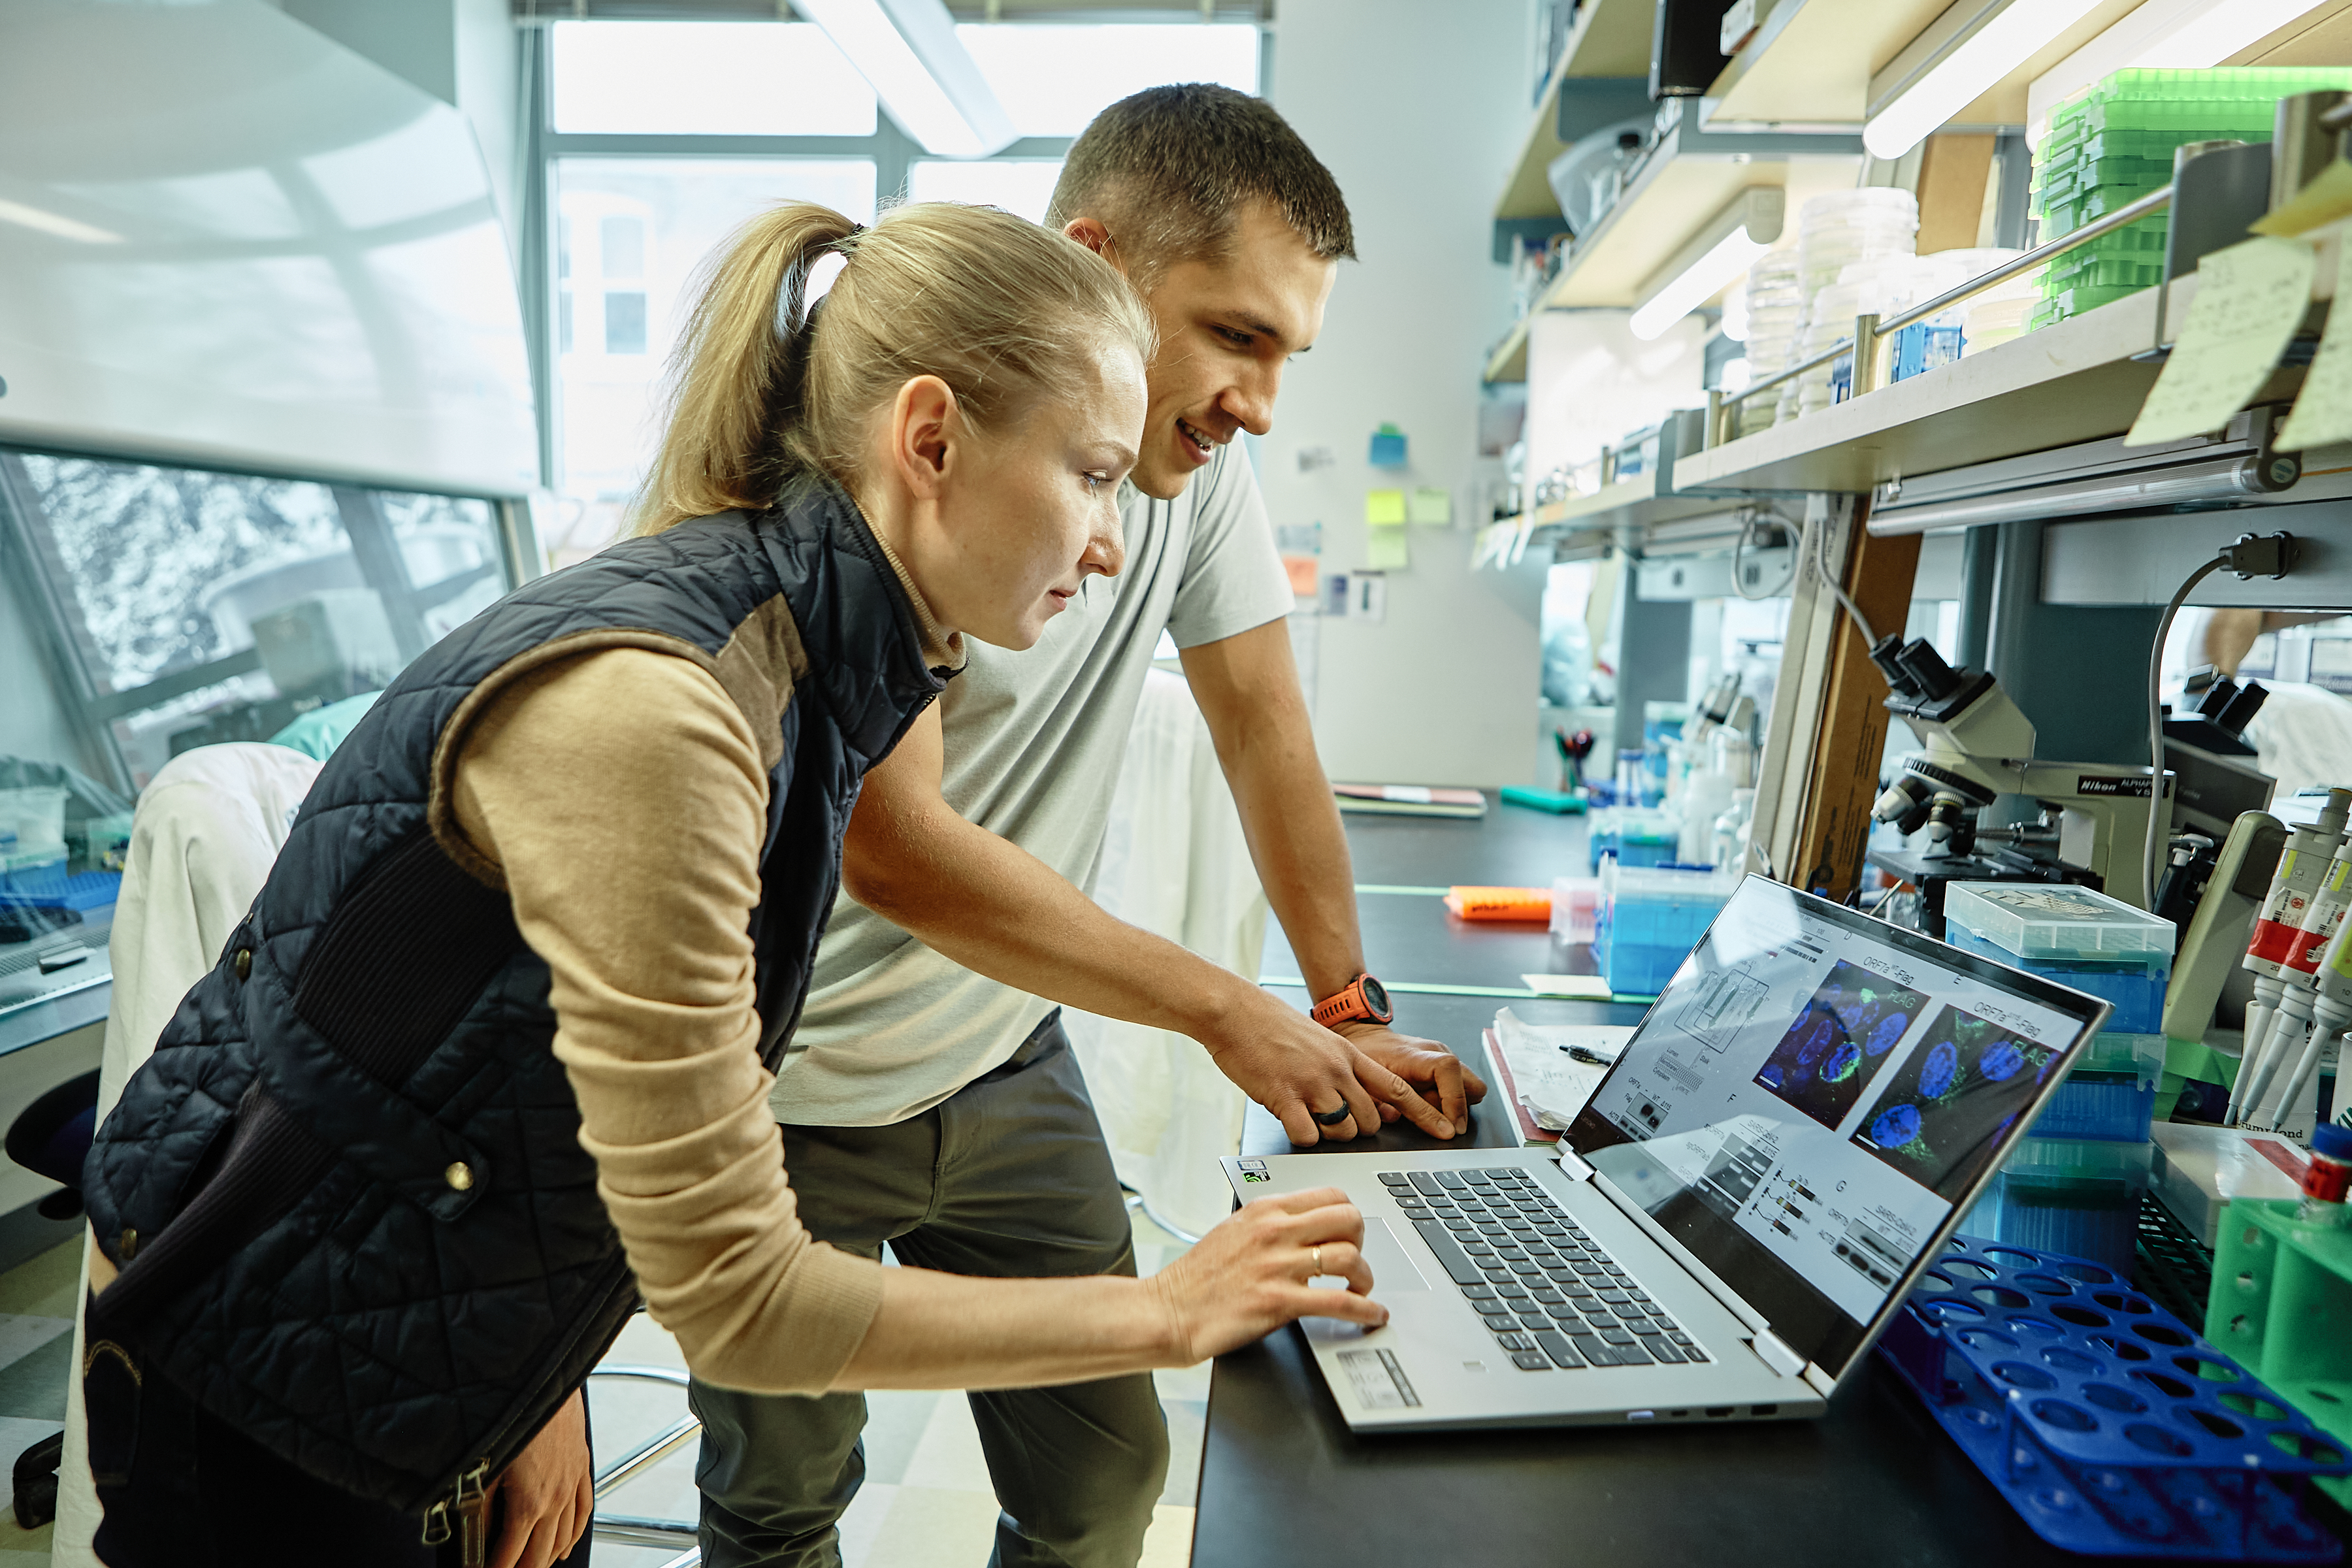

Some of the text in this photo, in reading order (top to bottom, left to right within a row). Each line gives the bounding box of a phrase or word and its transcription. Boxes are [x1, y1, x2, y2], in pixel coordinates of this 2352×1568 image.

[2081, 780, 2117, 792] Nikon
[1844, 930, 1852, 940] D
[1953, 974, 1962, 985] E
[1887, 990, 1917, 1009] FLAG
[2010, 1040, 2050, 1067] FLAG
[1699, 1055, 1709, 1064] Stalk
[1624, 1092, 1633, 1103] Flag
[1652, 1094, 1661, 1102] WT
[1727, 1094, 1737, 1103] F
[1608, 1111, 1620, 1121] ACTB
[1747, 1119, 1779, 1145] SARS-CoV-2
[1836, 1180, 1847, 1192] G
[1875, 1205, 1917, 1236] SARS-CoV-2
[1818, 1230, 1837, 1245] ACTB
